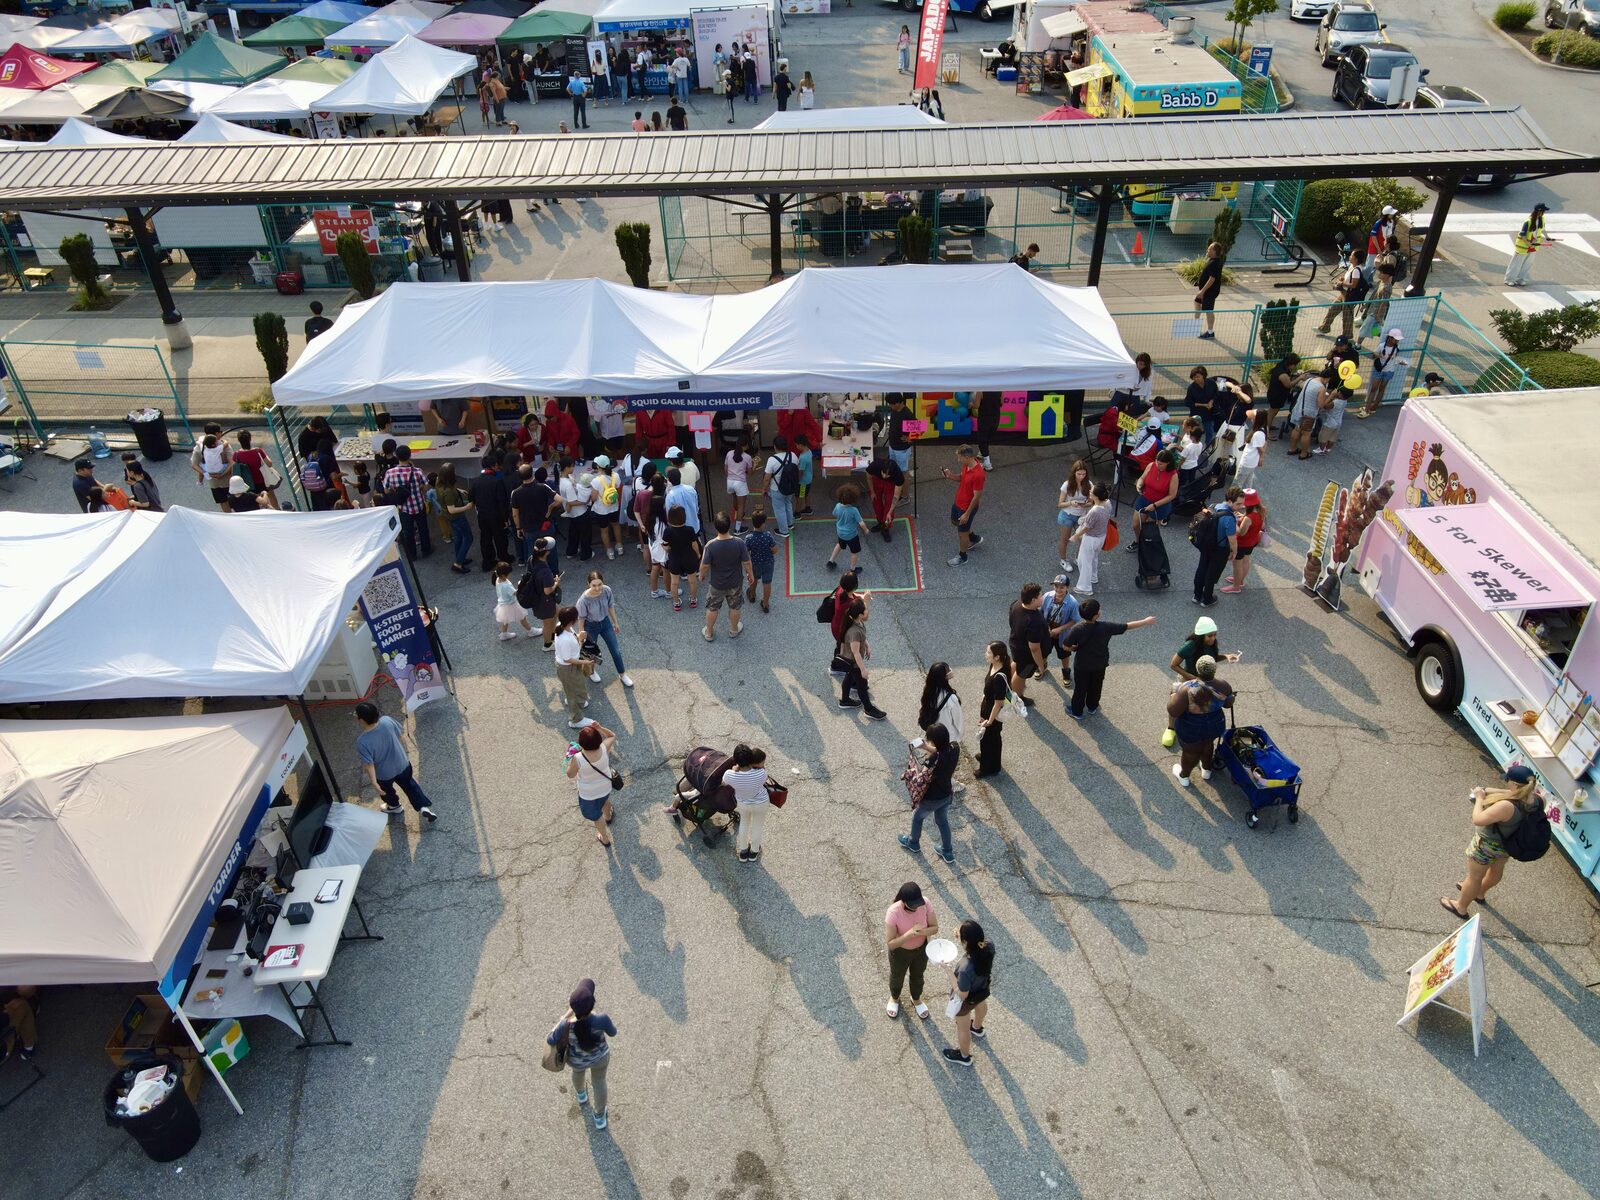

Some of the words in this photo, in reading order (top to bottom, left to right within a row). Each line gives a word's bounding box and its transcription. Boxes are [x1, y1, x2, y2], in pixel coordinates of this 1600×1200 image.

[931, 34, 940, 63] JAPANESE
[536, 80, 560, 88] AUNCH
[1162, 92, 1202, 108] Babb
[1206, 91, 1217, 107] D
[319, 218, 369, 226] STEAMED
[321, 228, 371, 243] BS
[631, 397, 660, 407] SQUID
[661, 397, 686, 406] GAME
[687, 397, 708, 406] MINI
[709, 396, 761, 406] CHALLENGE
[1428, 515, 1448, 524] S
[1446, 526, 1477, 545] for
[1478, 547, 1552, 593] Skewer
[373, 608, 414, 632] K-STREET
[377, 622, 402, 640] FOOD
[381, 626, 417, 649] MARKET
[1472, 696, 1492, 724] Fired
[1492, 724, 1503, 739] up
[1504, 737, 1517, 754] by
[1565, 810, 1578, 831] ed
[1579, 829, 1593, 850] by
[207, 841, 242, 906] T'ORDER
